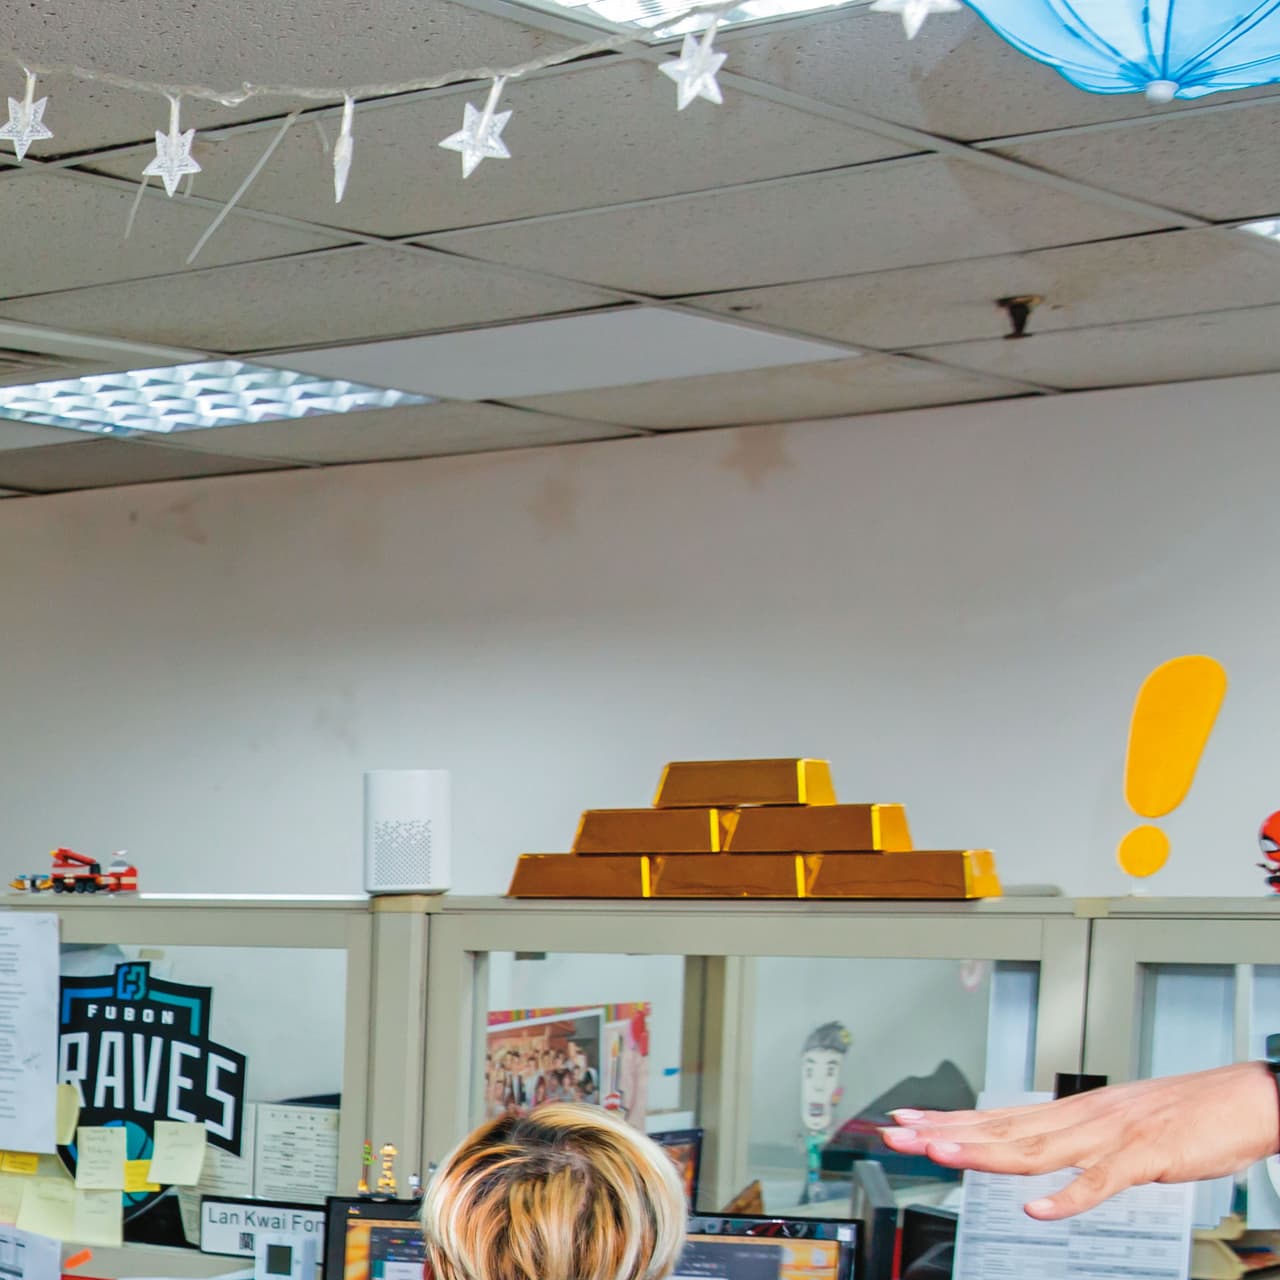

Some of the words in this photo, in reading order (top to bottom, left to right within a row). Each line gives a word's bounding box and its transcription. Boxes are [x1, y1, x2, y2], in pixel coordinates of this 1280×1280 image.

[87, 1004, 175, 1025] FUBON
[58, 1031, 238, 1141] RAVES
[208, 1207, 239, 1224] Lan
[244, 1210, 286, 1230] Kwai
[292, 1214, 325, 1232] Fon
